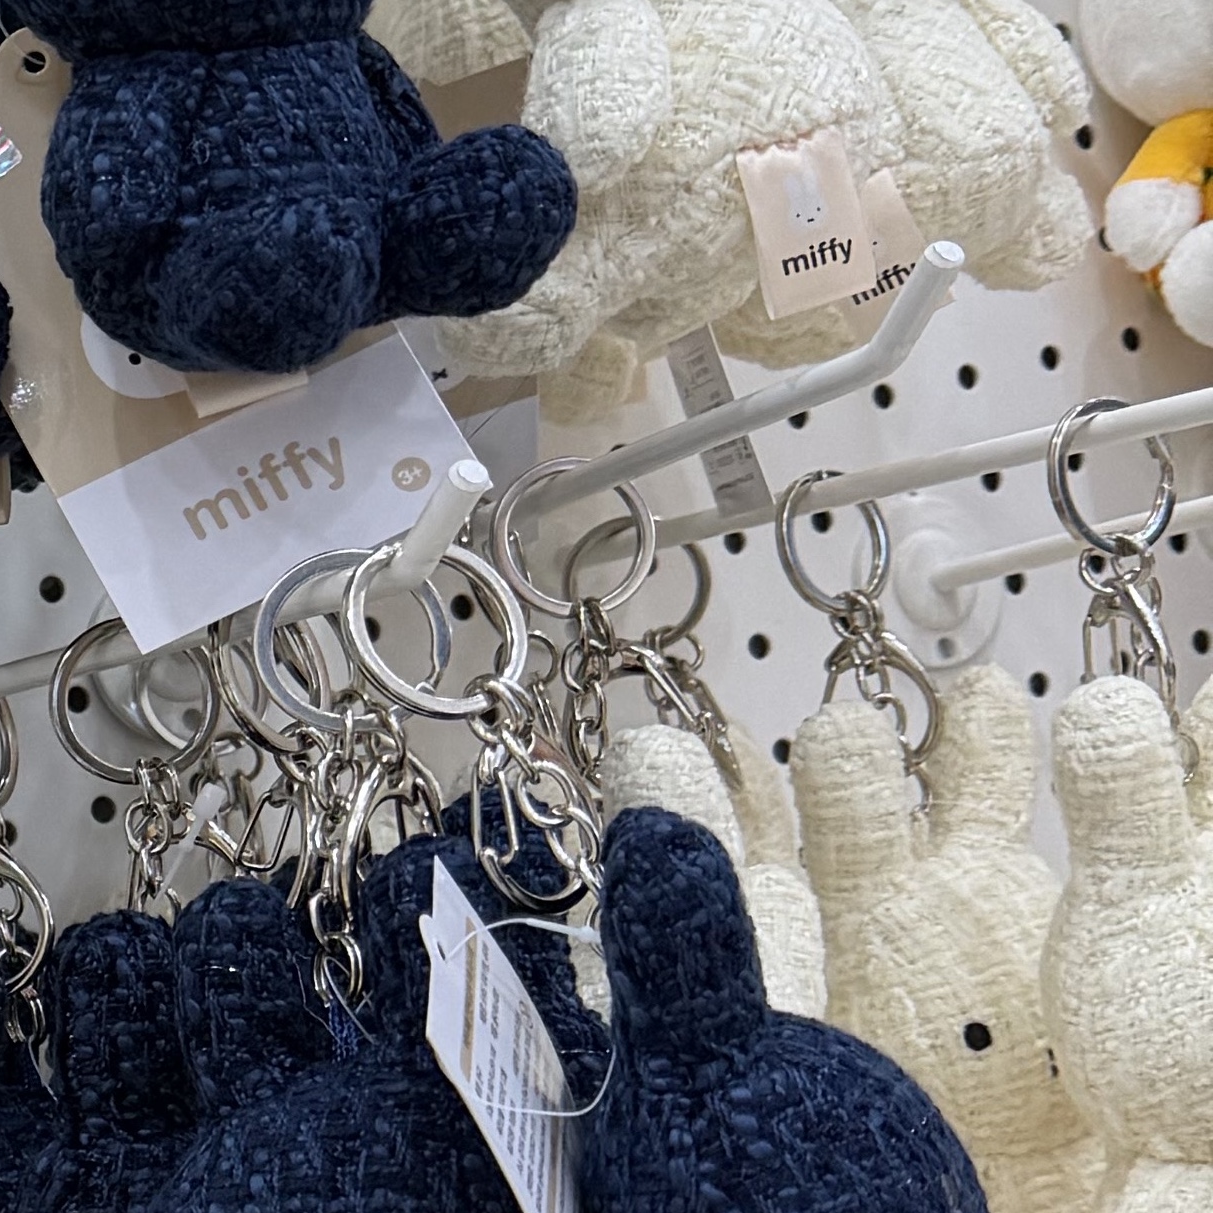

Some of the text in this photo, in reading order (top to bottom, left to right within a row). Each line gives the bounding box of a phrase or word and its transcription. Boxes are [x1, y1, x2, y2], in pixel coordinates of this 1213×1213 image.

[781, 237, 853, 277] miffy
[182, 436, 345, 541] miffy
[397, 464, 424, 486] 3+
